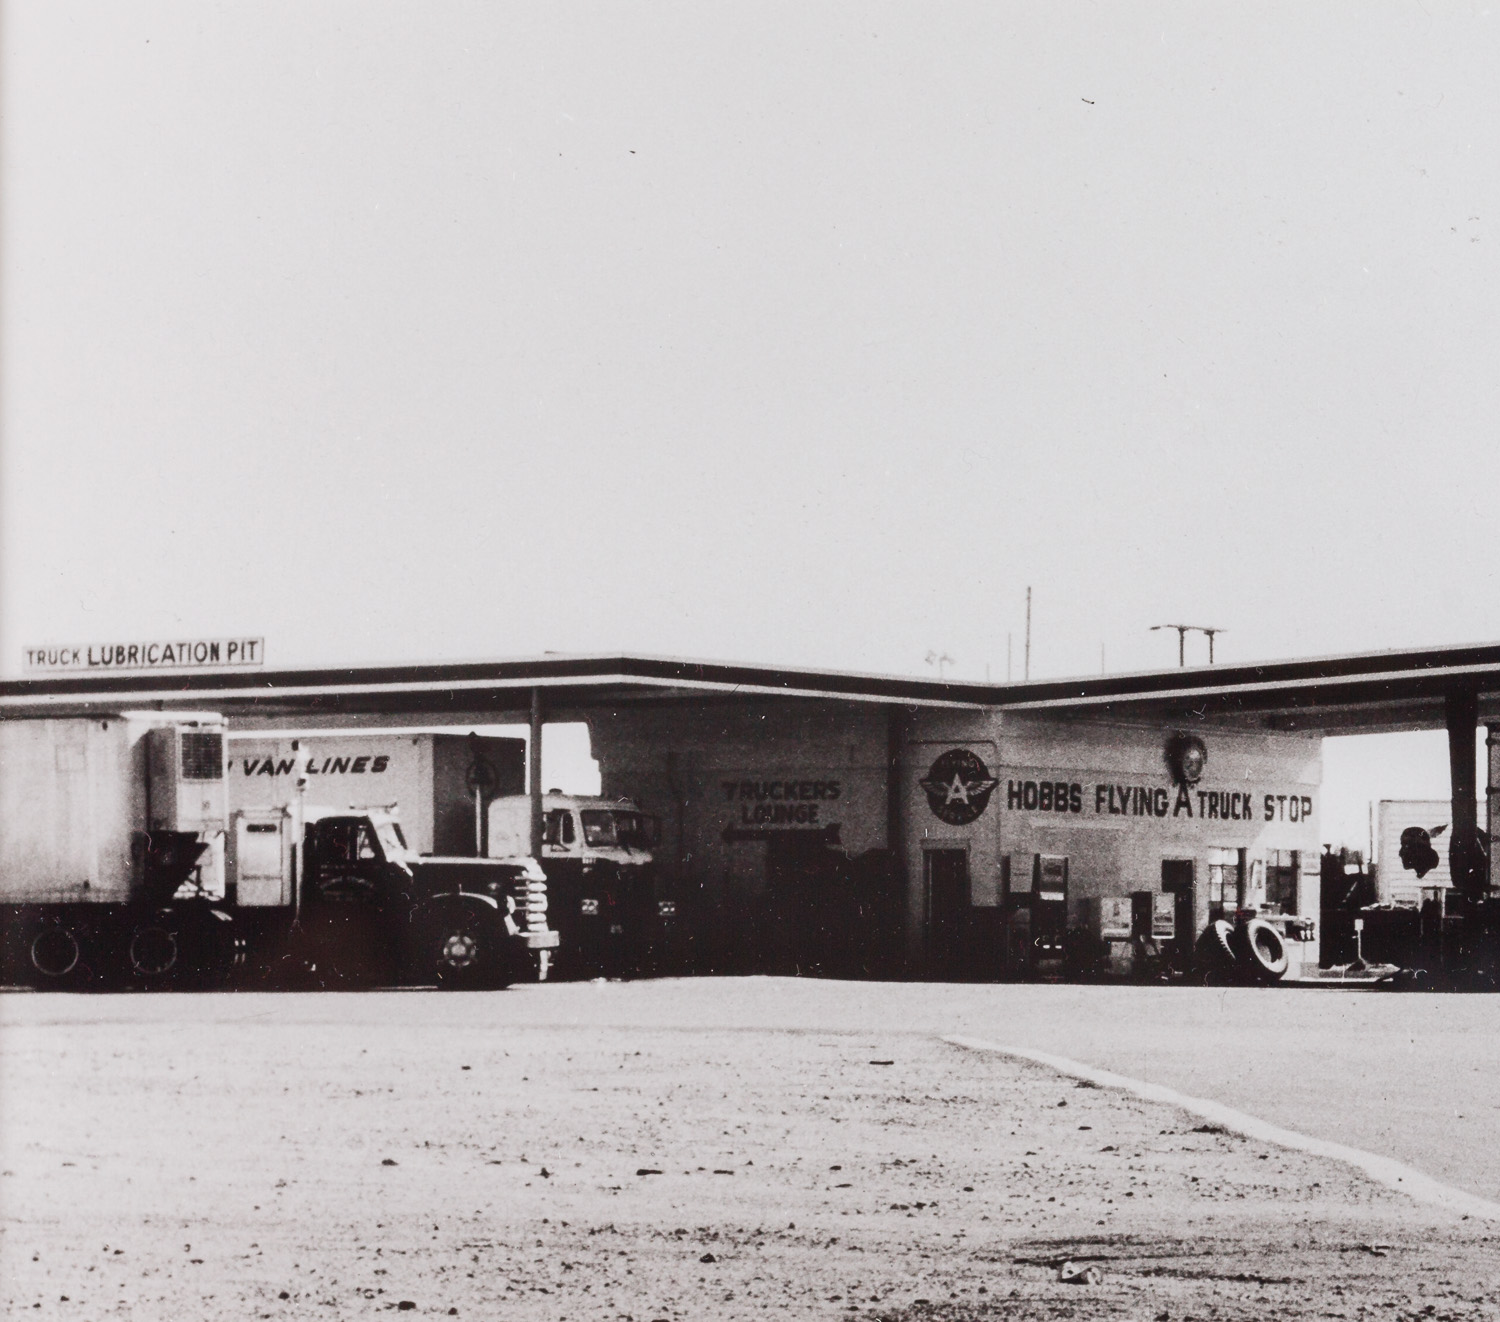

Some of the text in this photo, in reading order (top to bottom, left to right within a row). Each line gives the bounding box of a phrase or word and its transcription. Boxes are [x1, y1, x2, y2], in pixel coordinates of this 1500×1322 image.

[26, 640, 259, 666] TRUCK LUBRICATION PIT
[243, 757, 295, 777] VAN
[305, 755, 390, 775] LINES
[722, 780, 842, 800] TRUCKERS
[945, 772, 969, 805] A
[741, 803, 819, 824] LOUNGE
[1007, 780, 1082, 813] HOBBS
[1095, 784, 1169, 818] FLYING
[1173, 781, 1193, 818] A
[1197, 790, 1252, 821] TRUCK
[1264, 794, 1313, 823] STOP
